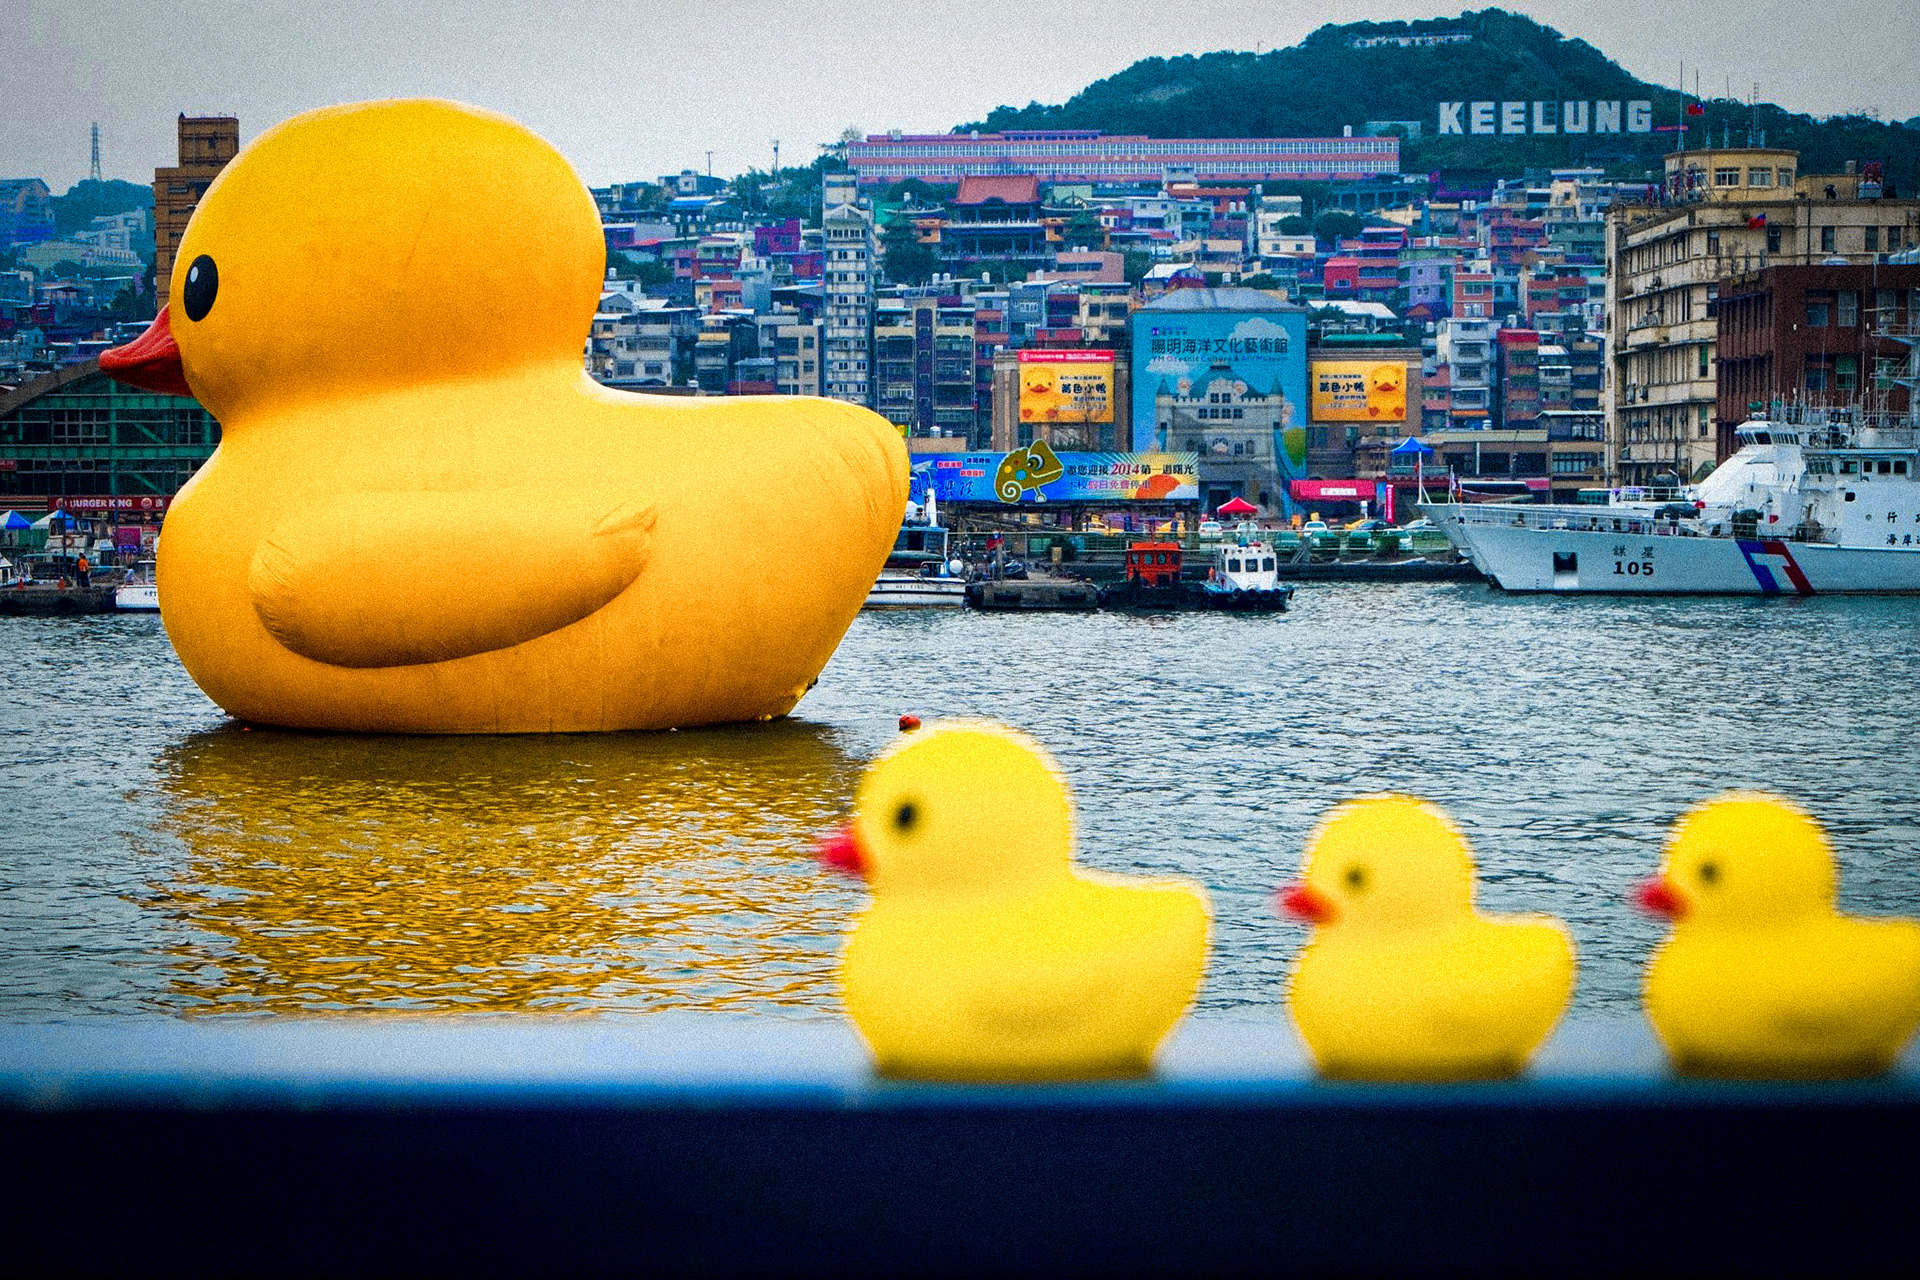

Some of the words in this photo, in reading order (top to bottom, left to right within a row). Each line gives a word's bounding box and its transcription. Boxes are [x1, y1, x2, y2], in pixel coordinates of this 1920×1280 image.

[1439, 100, 1652, 134] KEELUNG
[1151, 337, 1288, 354] 陽明海洋文化藝術館
[108, 498, 132, 507] KNG
[1612, 561, 1655, 576] 105
